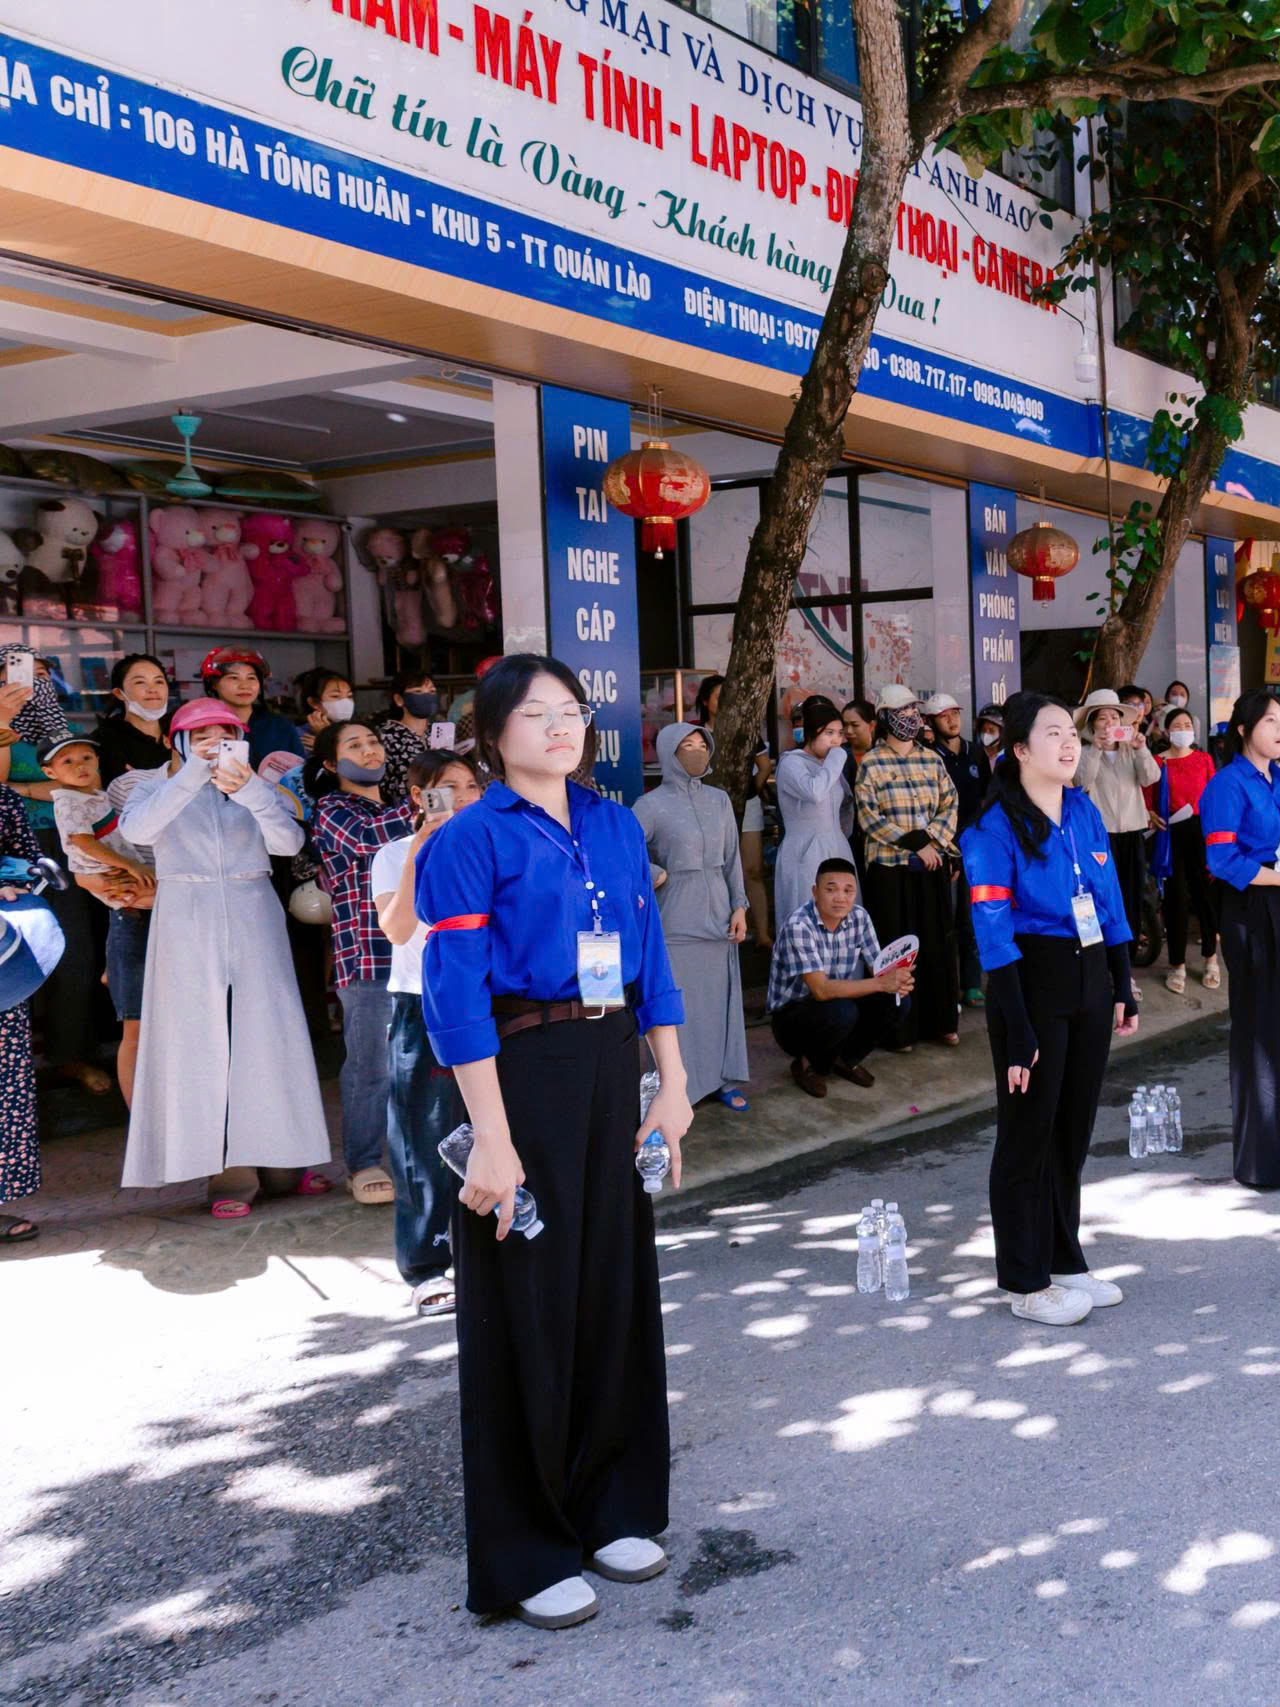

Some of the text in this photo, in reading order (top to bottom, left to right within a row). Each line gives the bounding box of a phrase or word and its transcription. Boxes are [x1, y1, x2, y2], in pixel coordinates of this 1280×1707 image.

[600, 0, 670, 56] MẠI
[682, 32, 724, 84] VÀ
[737, 60, 815, 127] DỊCH
[824, 104, 863, 155] VỤ
[929, 161, 978, 207] ANH
[473, 3, 562, 105] MÁY
[578, 48, 663, 150] TÍNH
[691, 103, 806, 205] LAPTOP
[896, 201, 958, 279] THOẠI
[0, 56, 38, 108] ỊA
[50, 75, 111, 130] CHỈ
[139, 106, 196, 156] 106
[205, 124, 249, 175] HÀ
[255, 141, 331, 200] TÔNG
[337, 175, 411, 225] HUÂN
[431, 203, 480, 247] KHU
[486, 221, 501, 253] 5
[521, 233, 547, 268] TT
[553, 248, 610, 288] QUÁN
[615, 261, 652, 301] LÀO
[281, 46, 377, 120] Chữ
[391, 94, 452, 147] tín
[466, 117, 508, 168] là
[520, 140, 628, 219] Vàng
[652, 190, 758, 260] Khách
[766, 232, 834, 293] hàng
[684, 286, 726, 328] ĐIỆN
[728, 301, 776, 344] THOẠI
[573, 425, 609, 463] PIN
[575, 486, 608, 523] TAI
[984, 504, 1007, 534] BÁN
[567, 547, 620, 585] NGHE
[985, 548, 1008, 577] VĂN
[576, 602, 616, 642] CÁP
[979, 589, 1015, 621] PHÒNG
[983, 629, 1014, 663] PHẨM
[578, 669, 617, 709] SẠC
